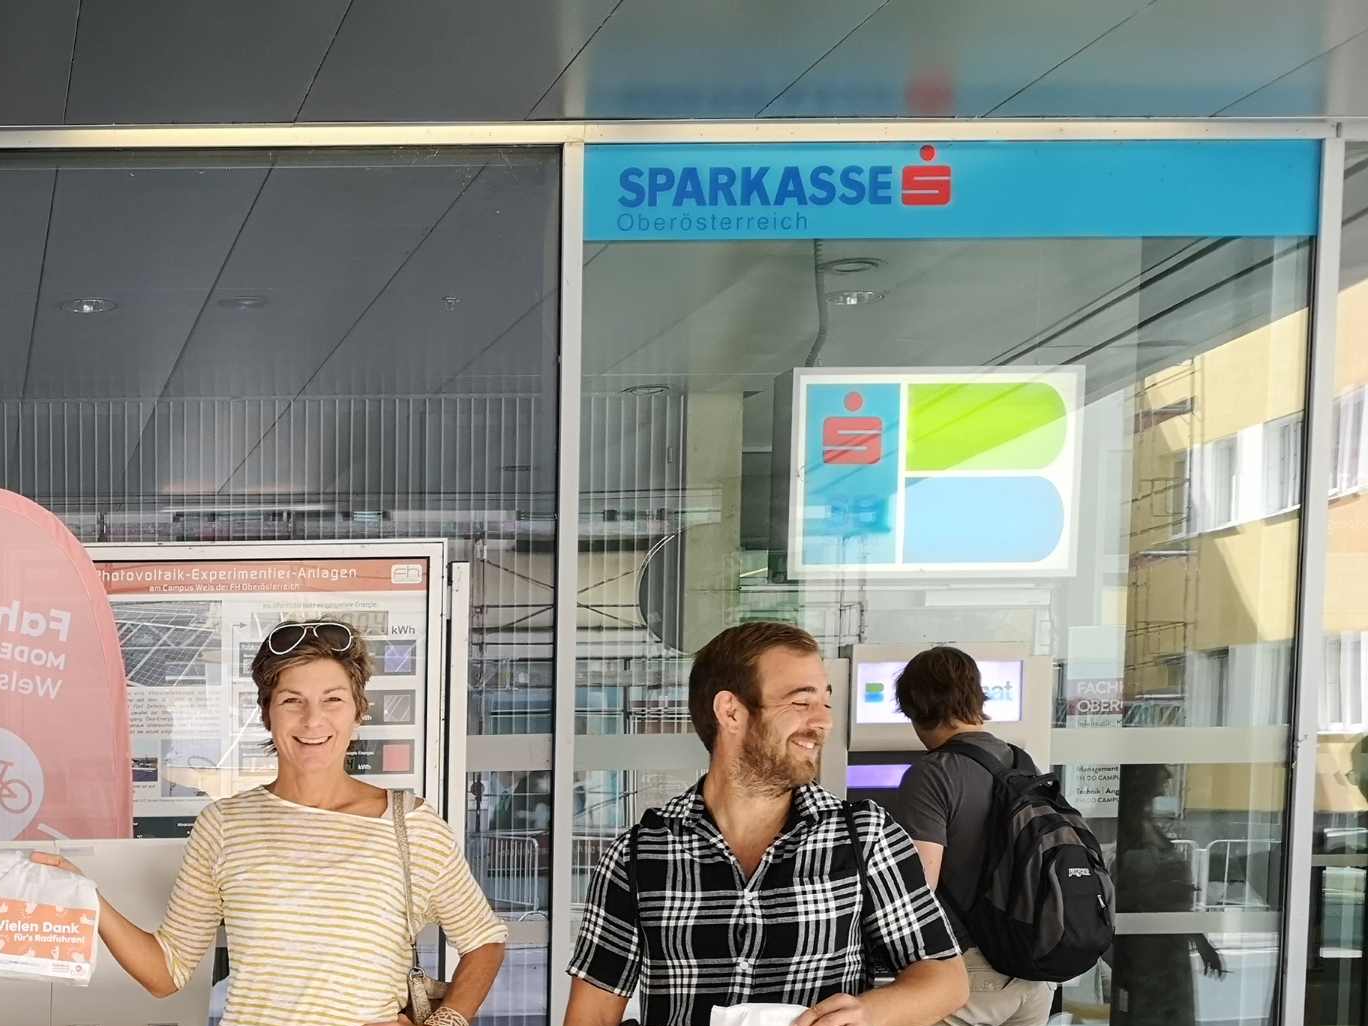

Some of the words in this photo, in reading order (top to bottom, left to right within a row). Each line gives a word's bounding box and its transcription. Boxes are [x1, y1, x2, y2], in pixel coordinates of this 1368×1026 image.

[618, 166, 892, 208] SPARKASSE
[617, 212, 807, 231] Oberösterreich
[163, 584, 193, 593] Campus
[196, 583, 214, 591] Wels
[215, 583, 229, 591] der
[230, 583, 241, 591] FH
[242, 582, 300, 591] Oberösterreich
[391, 625, 415, 635] kWh
[1077, 699, 1123, 713] OBER
[1076, 765, 1119, 774] Management
[1076, 787, 1101, 795] Technik
[42, 921, 80, 934] Dank
[13, 933, 33, 942] für's
[35, 934, 85, 944] Radfahren!
